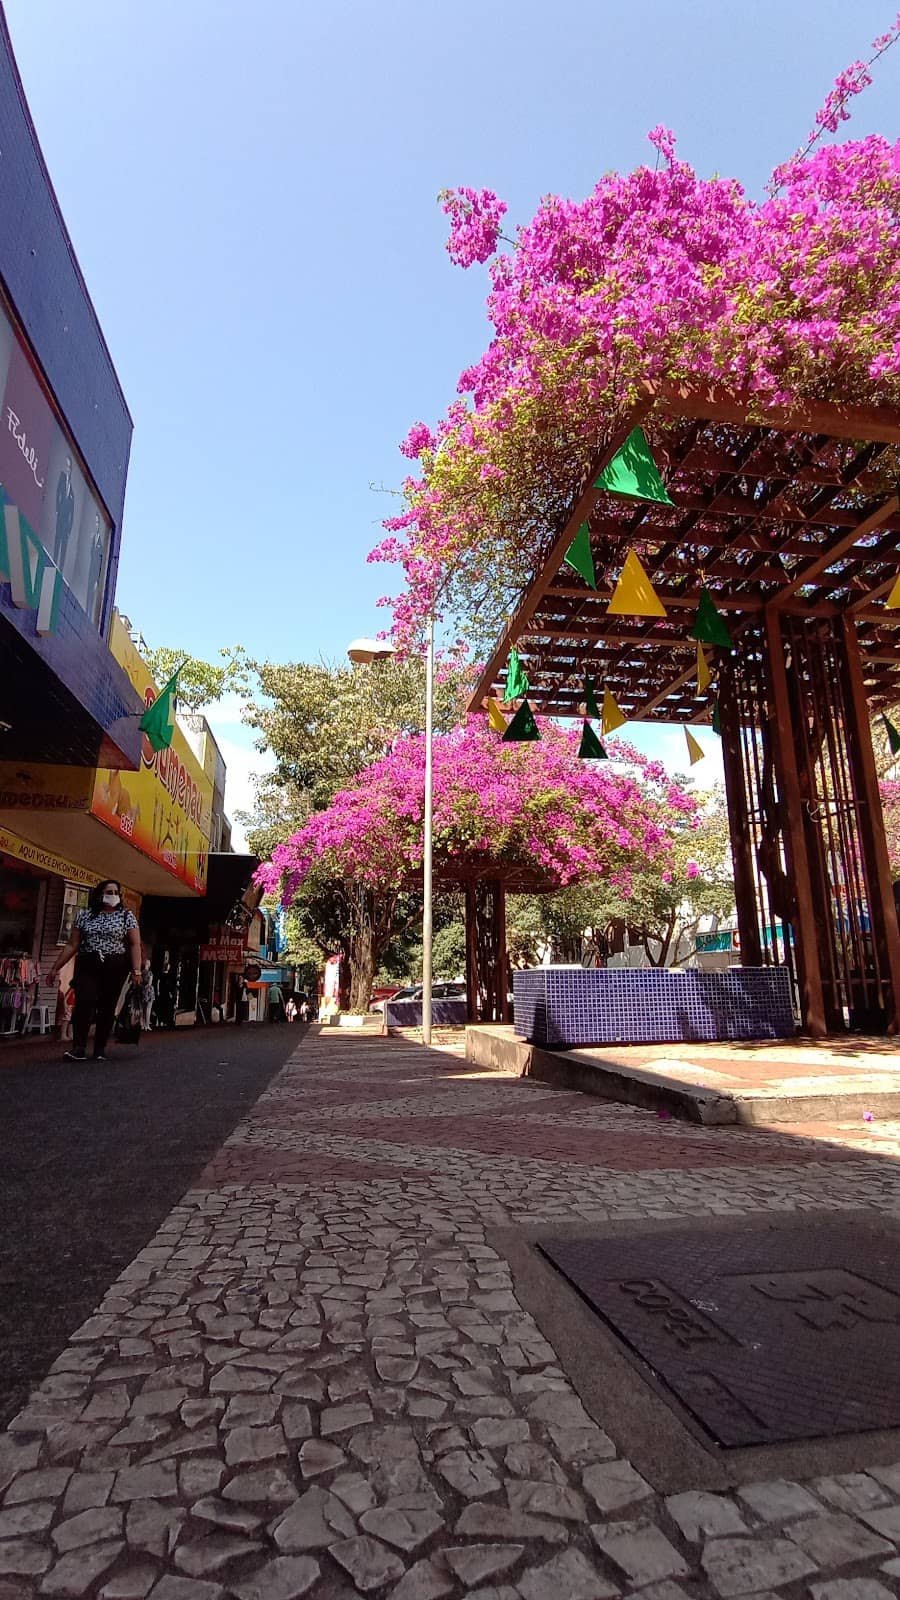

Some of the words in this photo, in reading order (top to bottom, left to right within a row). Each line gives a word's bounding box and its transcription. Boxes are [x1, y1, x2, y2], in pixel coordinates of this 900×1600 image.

[18, 844, 35, 860] AQUI
[219, 935, 245, 946] Max
[618, 1280, 717, 1350] COPEL
